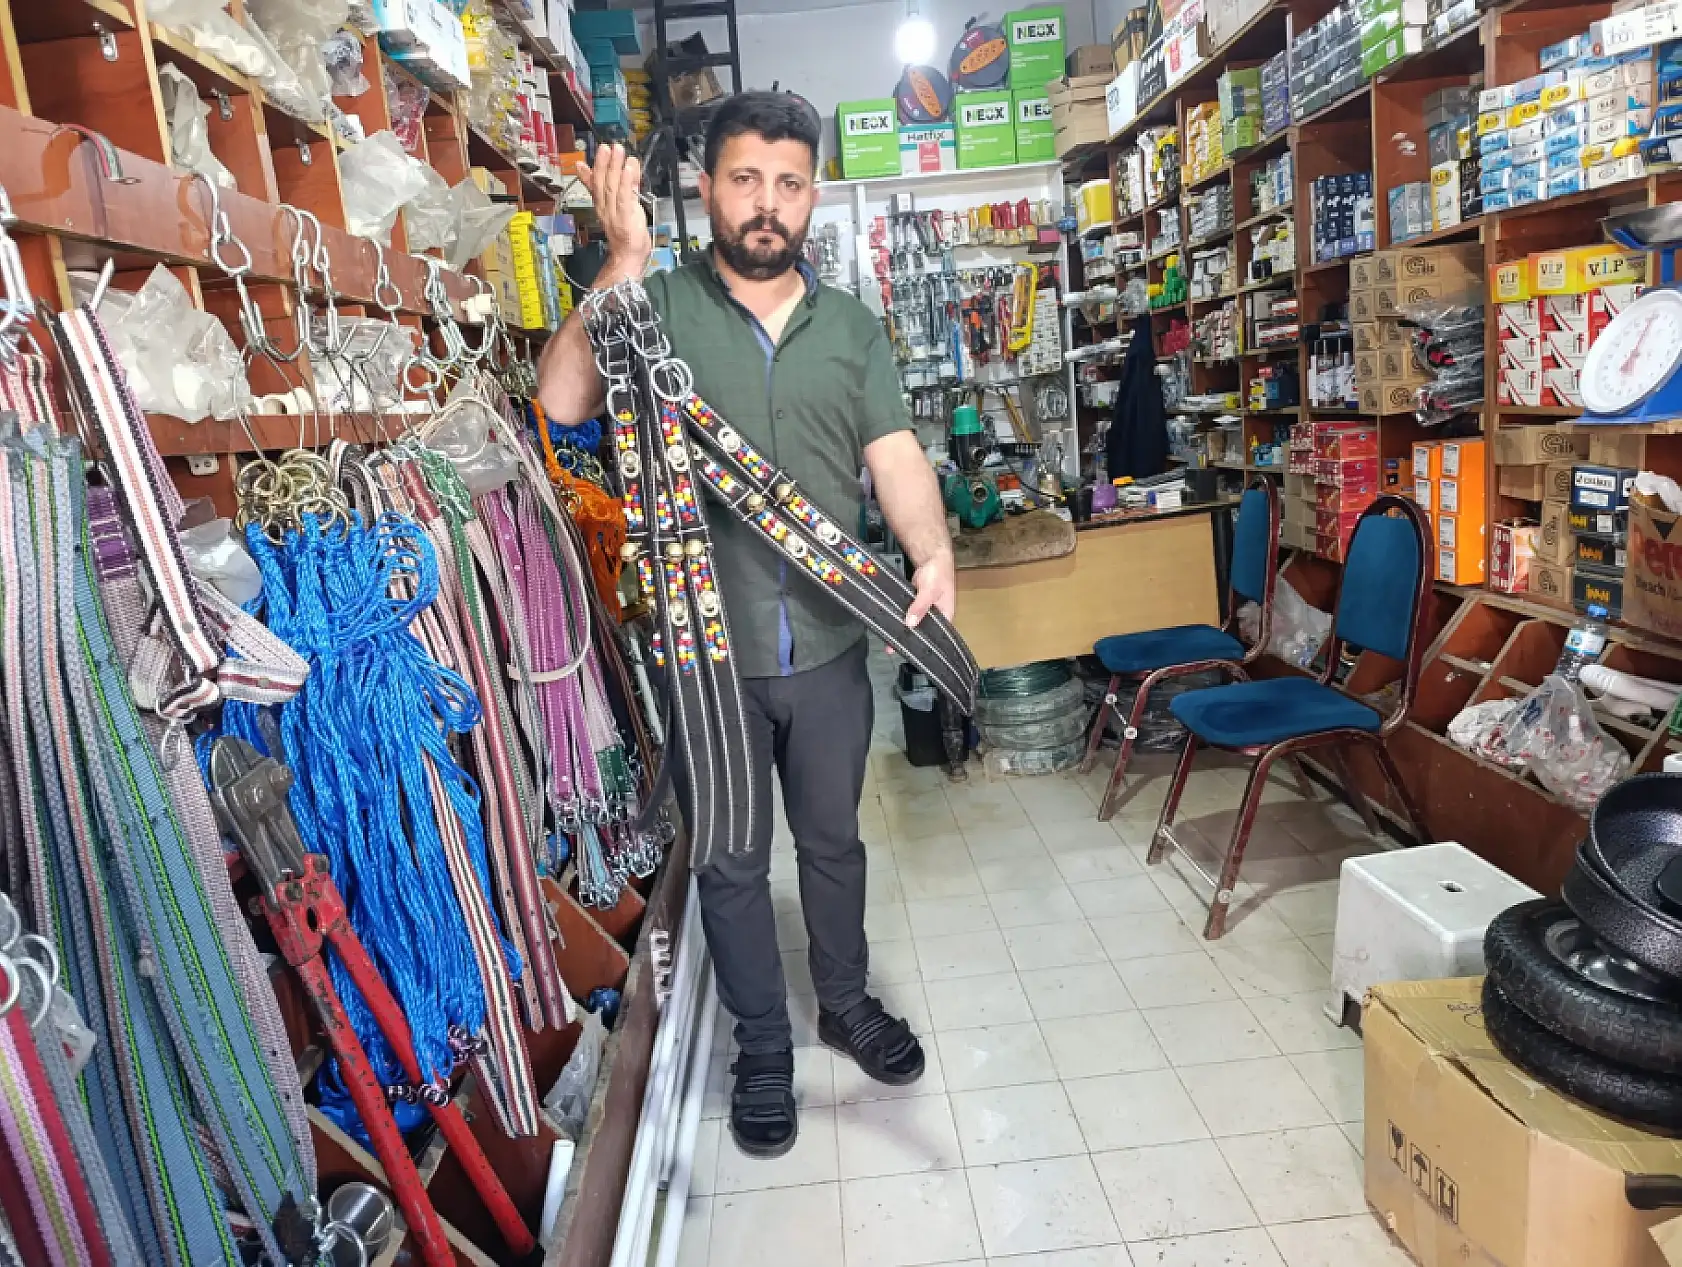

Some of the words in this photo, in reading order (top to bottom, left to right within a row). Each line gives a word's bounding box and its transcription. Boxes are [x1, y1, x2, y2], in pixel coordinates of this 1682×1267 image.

[1016, 23, 1056, 39] NEOX
[966, 106, 1005, 123] NEOX
[1023, 103, 1052, 117] NEO
[849, 115, 889, 131] NEOX
